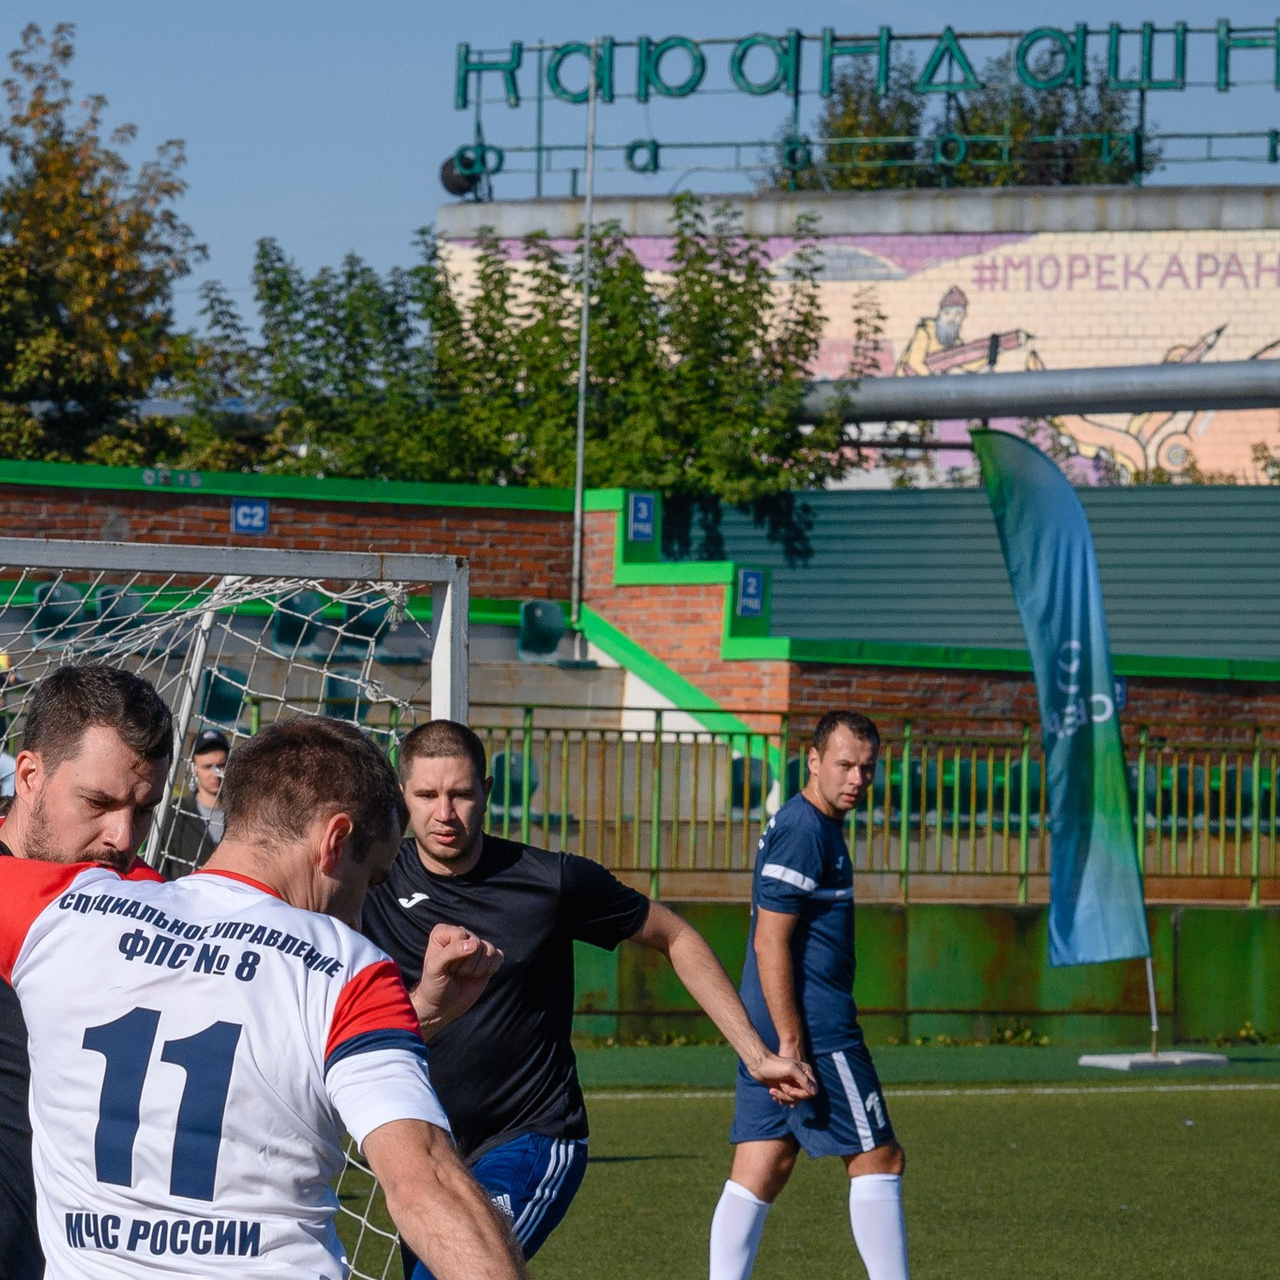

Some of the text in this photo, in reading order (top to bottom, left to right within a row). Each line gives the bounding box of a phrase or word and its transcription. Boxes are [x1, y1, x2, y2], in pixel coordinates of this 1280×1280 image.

[638, 501, 649, 519] 3
[746, 577, 758, 595] 2
[119, 929, 195, 969] ФПС
[234, 950, 262, 983] 8
[209, 921, 345, 978] УПРАВЛЕНИЕ
[81, 1006, 243, 1202] 11
[65, 1213, 262, 1257] МЧС РОССИИ
